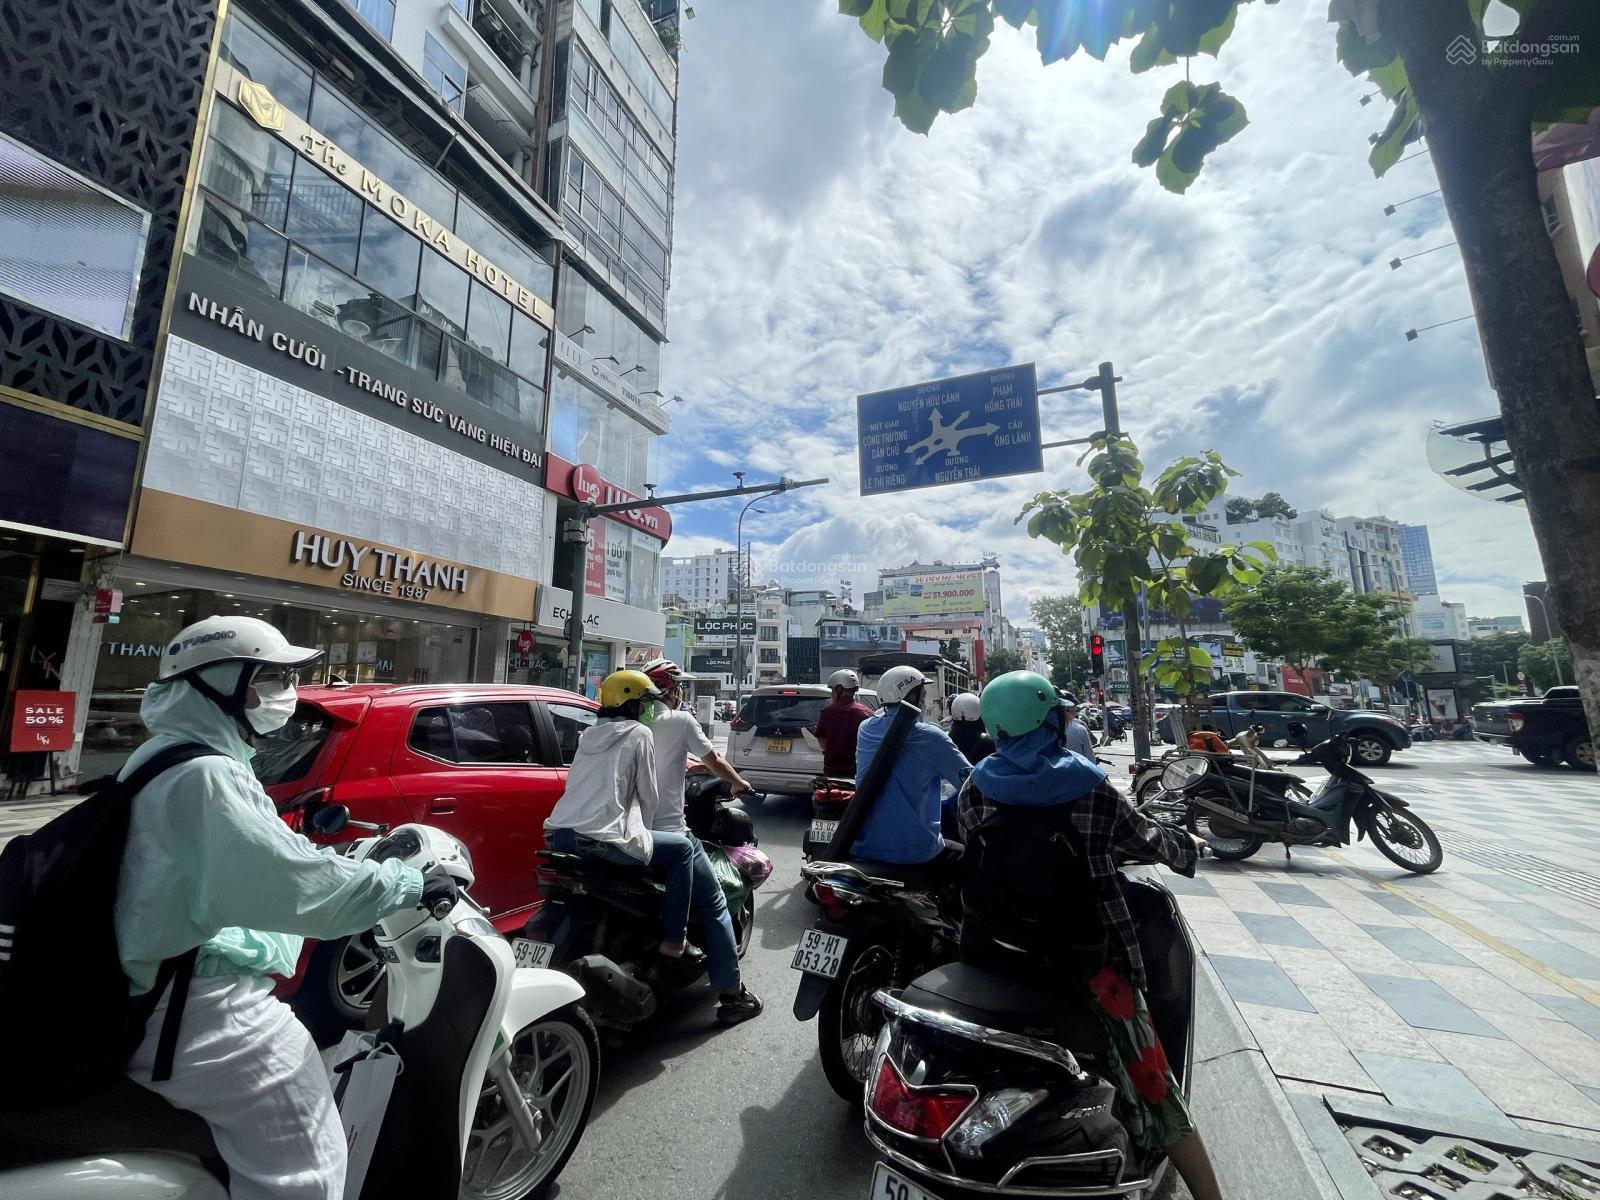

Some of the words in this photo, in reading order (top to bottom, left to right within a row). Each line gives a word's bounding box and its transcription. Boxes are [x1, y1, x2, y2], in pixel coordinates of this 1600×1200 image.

[301, 133, 346, 175] The
[360, 169, 453, 252] MOKA
[466, 248, 543, 318] HOTEL
[188, 291, 264, 342] NHẪN
[272, 332, 326, 370] CƯỚI
[412, 397, 445, 424] SỨC
[449, 414, 486, 444] VÀNG
[490, 433, 520, 458] HIỆN
[522, 447, 542, 469] ĐẠI
[293, 531, 369, 571] HUY
[374, 549, 469, 593] THANH
[342, 573, 393, 594] SINCE
[400, 584, 431, 600] 1987
[932, 588, 975, 599] 51.900.000
[697, 620, 721, 632] LỘC
[107, 641, 167, 658] THAN
[896, 675, 916, 690] FILA
[25, 707, 64, 715] SALE
[25, 716, 64, 725] 50%
[515, 941, 547, 966] 59-U2
[805, 931, 841, 956] 59-H1
[795, 949, 840, 976] 053.28
